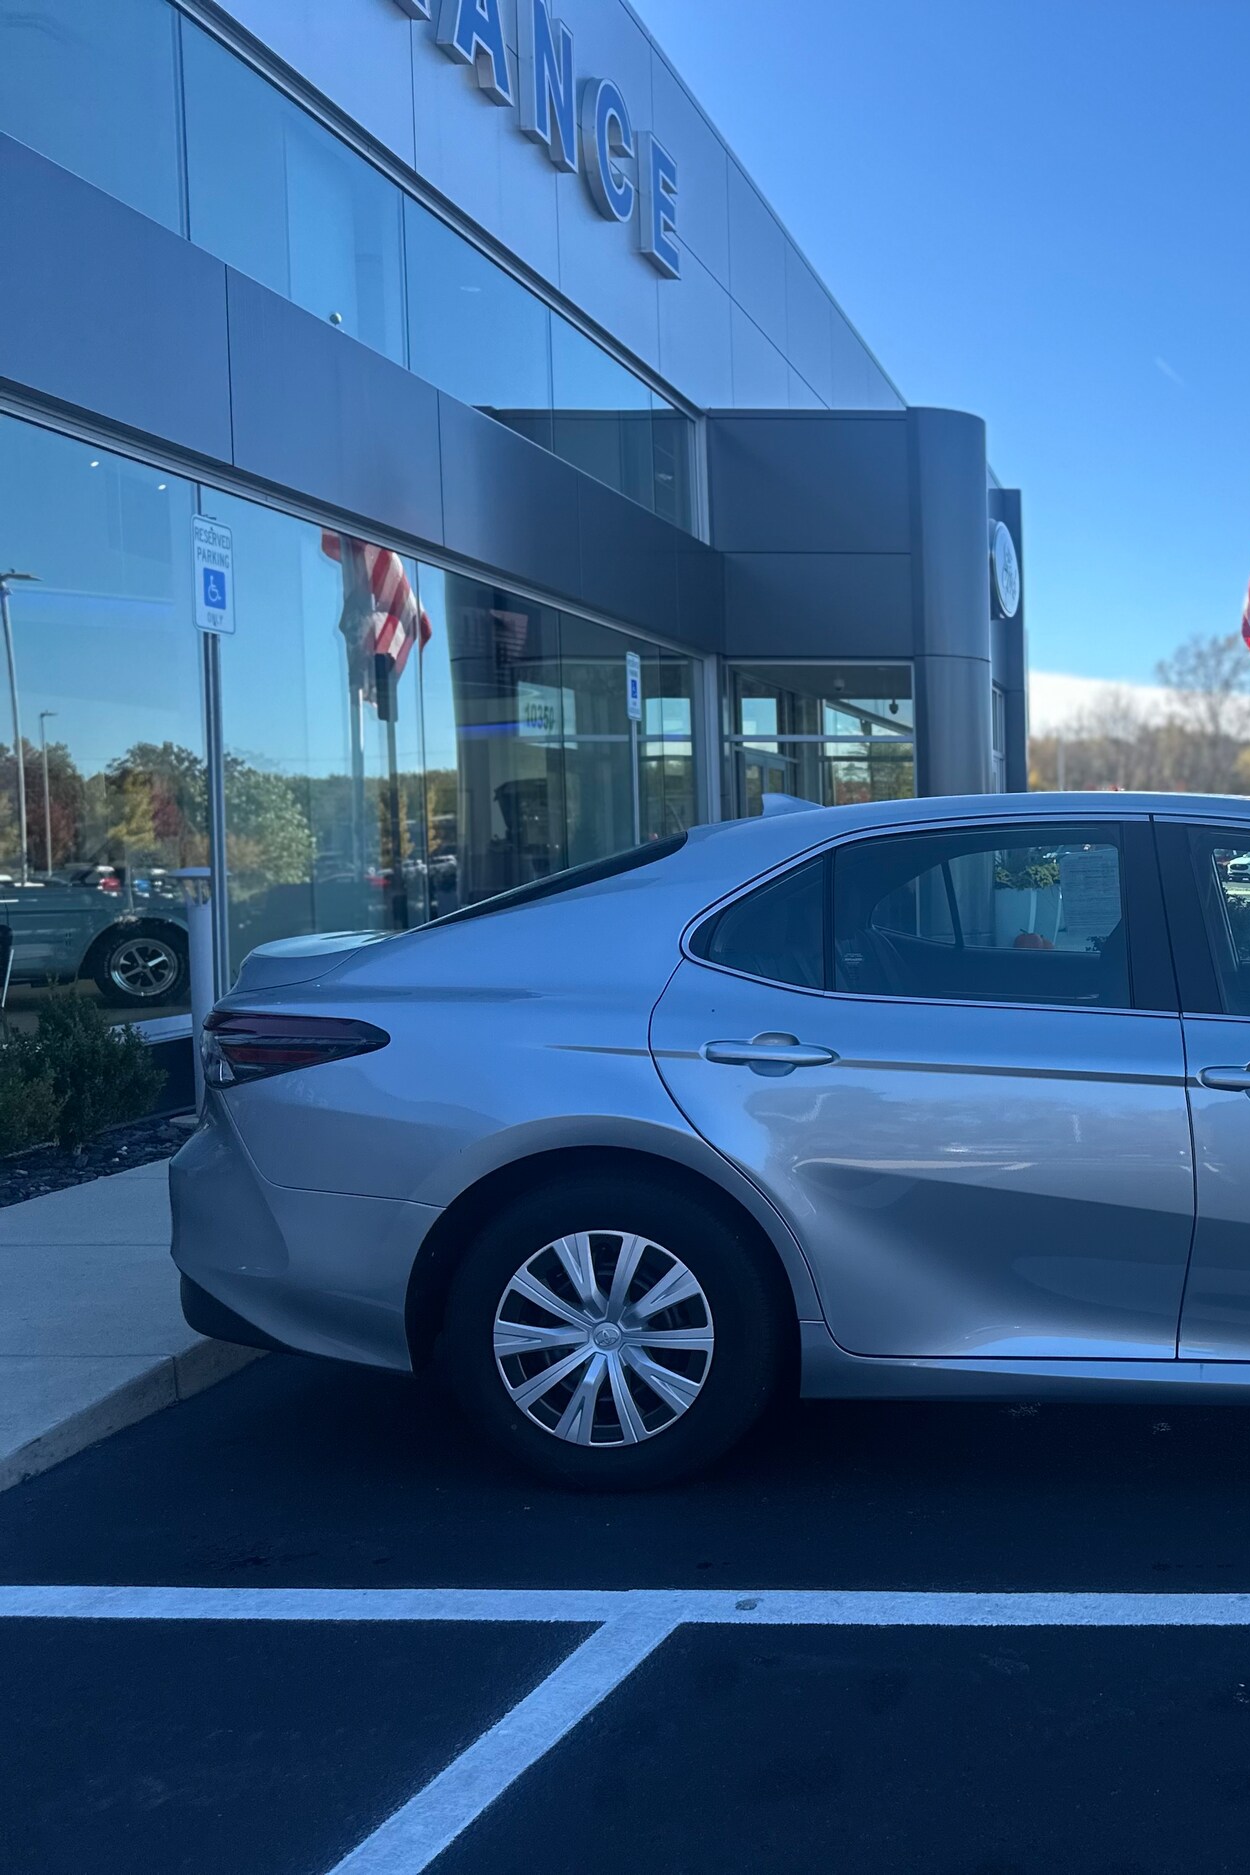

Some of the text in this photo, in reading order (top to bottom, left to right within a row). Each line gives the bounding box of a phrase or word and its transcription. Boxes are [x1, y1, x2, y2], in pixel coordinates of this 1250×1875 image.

[393, 0, 681, 280] ANCE
[194, 526, 231, 550] RESERVED
[196, 546, 230, 569] PARKING
[206, 611, 224, 625] ONLY
